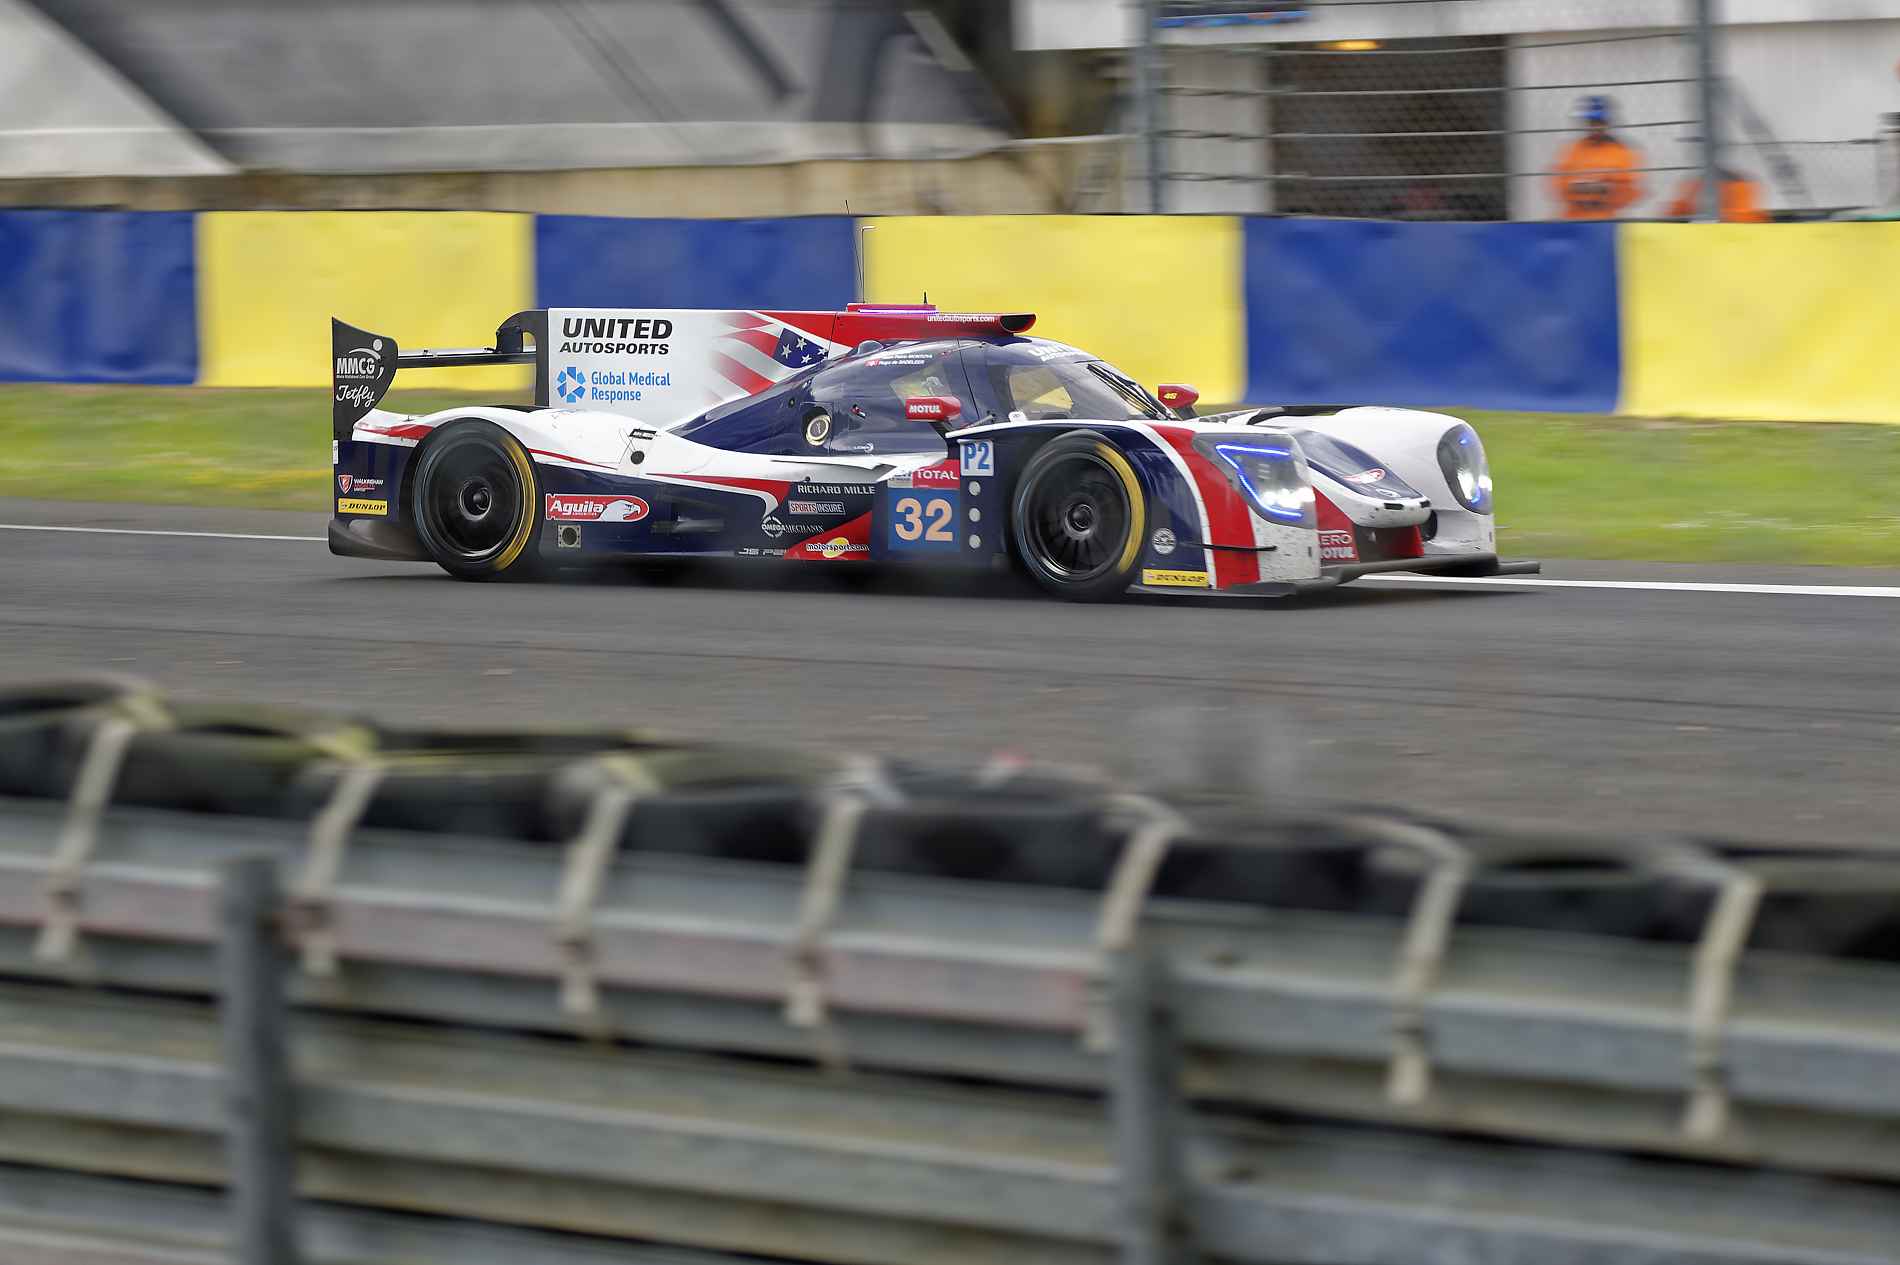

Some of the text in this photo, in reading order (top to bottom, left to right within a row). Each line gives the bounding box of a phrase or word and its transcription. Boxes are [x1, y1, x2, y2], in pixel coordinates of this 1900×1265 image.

[562, 318, 673, 339] UNITED
[559, 342, 669, 355] AUTOSPORTS
[336, 357, 375, 375] MMCG
[591, 371, 671, 386] Global Medical
[336, 385, 375, 408] Jetfly
[591, 387, 641, 405] Response
[909, 405, 942, 414] MOTUL
[963, 442, 990, 470] P2
[917, 469, 959, 480] TOTAL
[797, 484, 877, 495] RICHARD MILLE
[348, 502, 386, 512] DUNLOP
[550, 500, 604, 516] Aguila
[895, 497, 954, 542] 32
